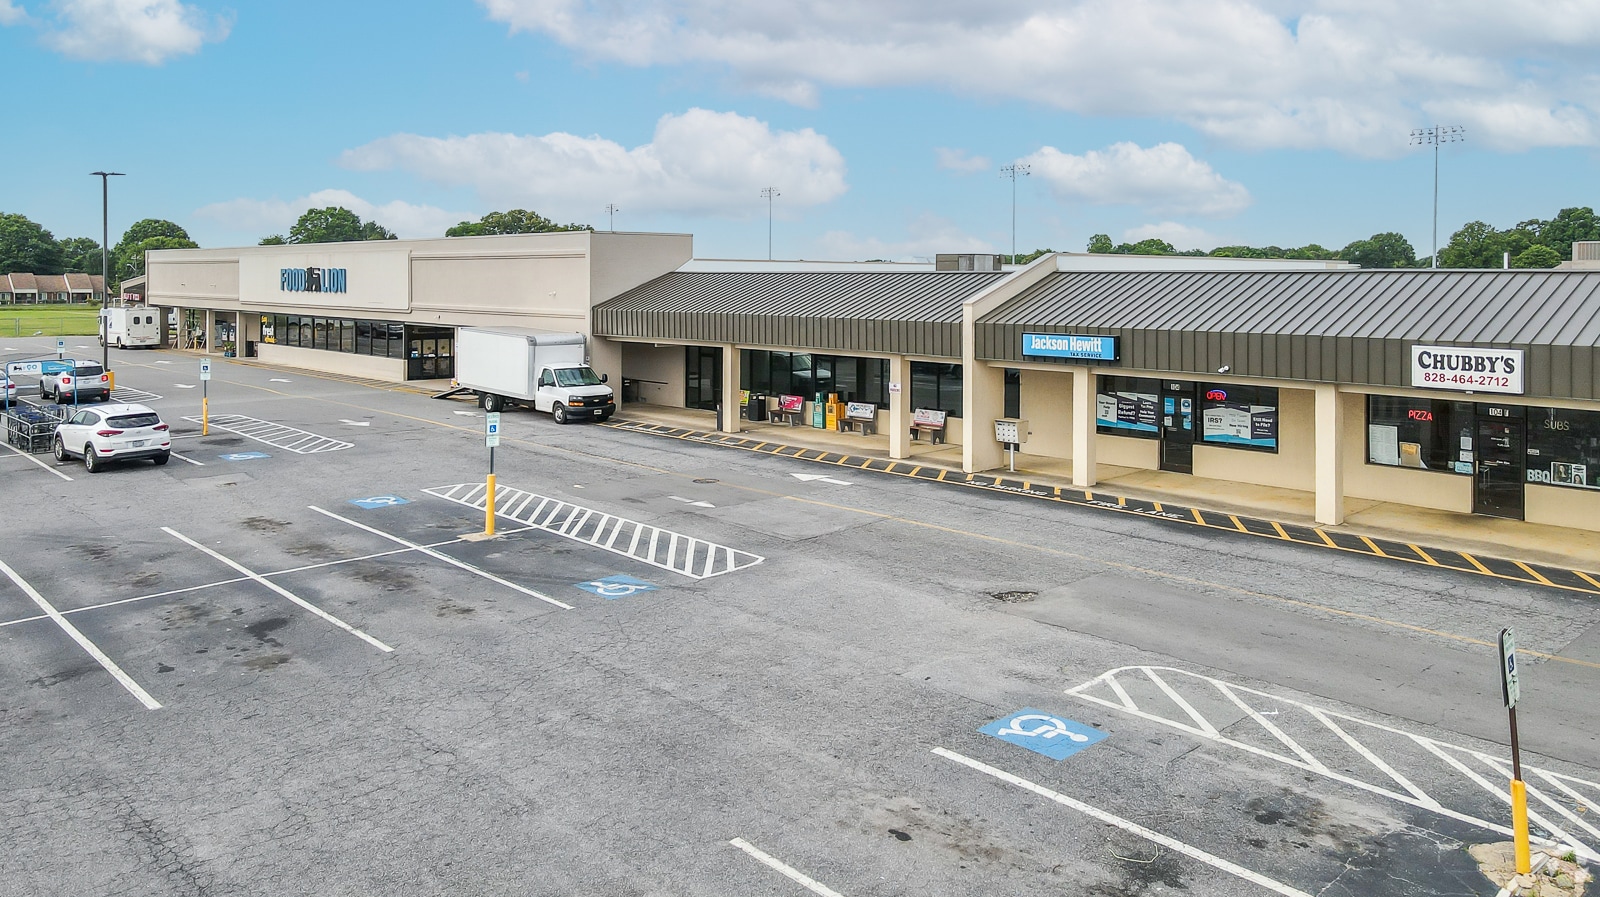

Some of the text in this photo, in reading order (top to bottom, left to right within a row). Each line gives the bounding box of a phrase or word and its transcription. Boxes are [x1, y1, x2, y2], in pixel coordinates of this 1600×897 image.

[280, 268, 347, 294] FOOD LION
[1030, 335, 1102, 352] Jackson Hewitt
[1418, 350, 1515, 374] CHUBBY'S
[1424, 372, 1509, 387] 828-464-2712
[1206, 391, 1226, 400] OPEN
[1408, 410, 1433, 421] PIZZA
[1544, 419, 1570, 430] SUBS
[1526, 469, 1551, 484] BBQ
[1134, 508, 1184, 518] LANE
